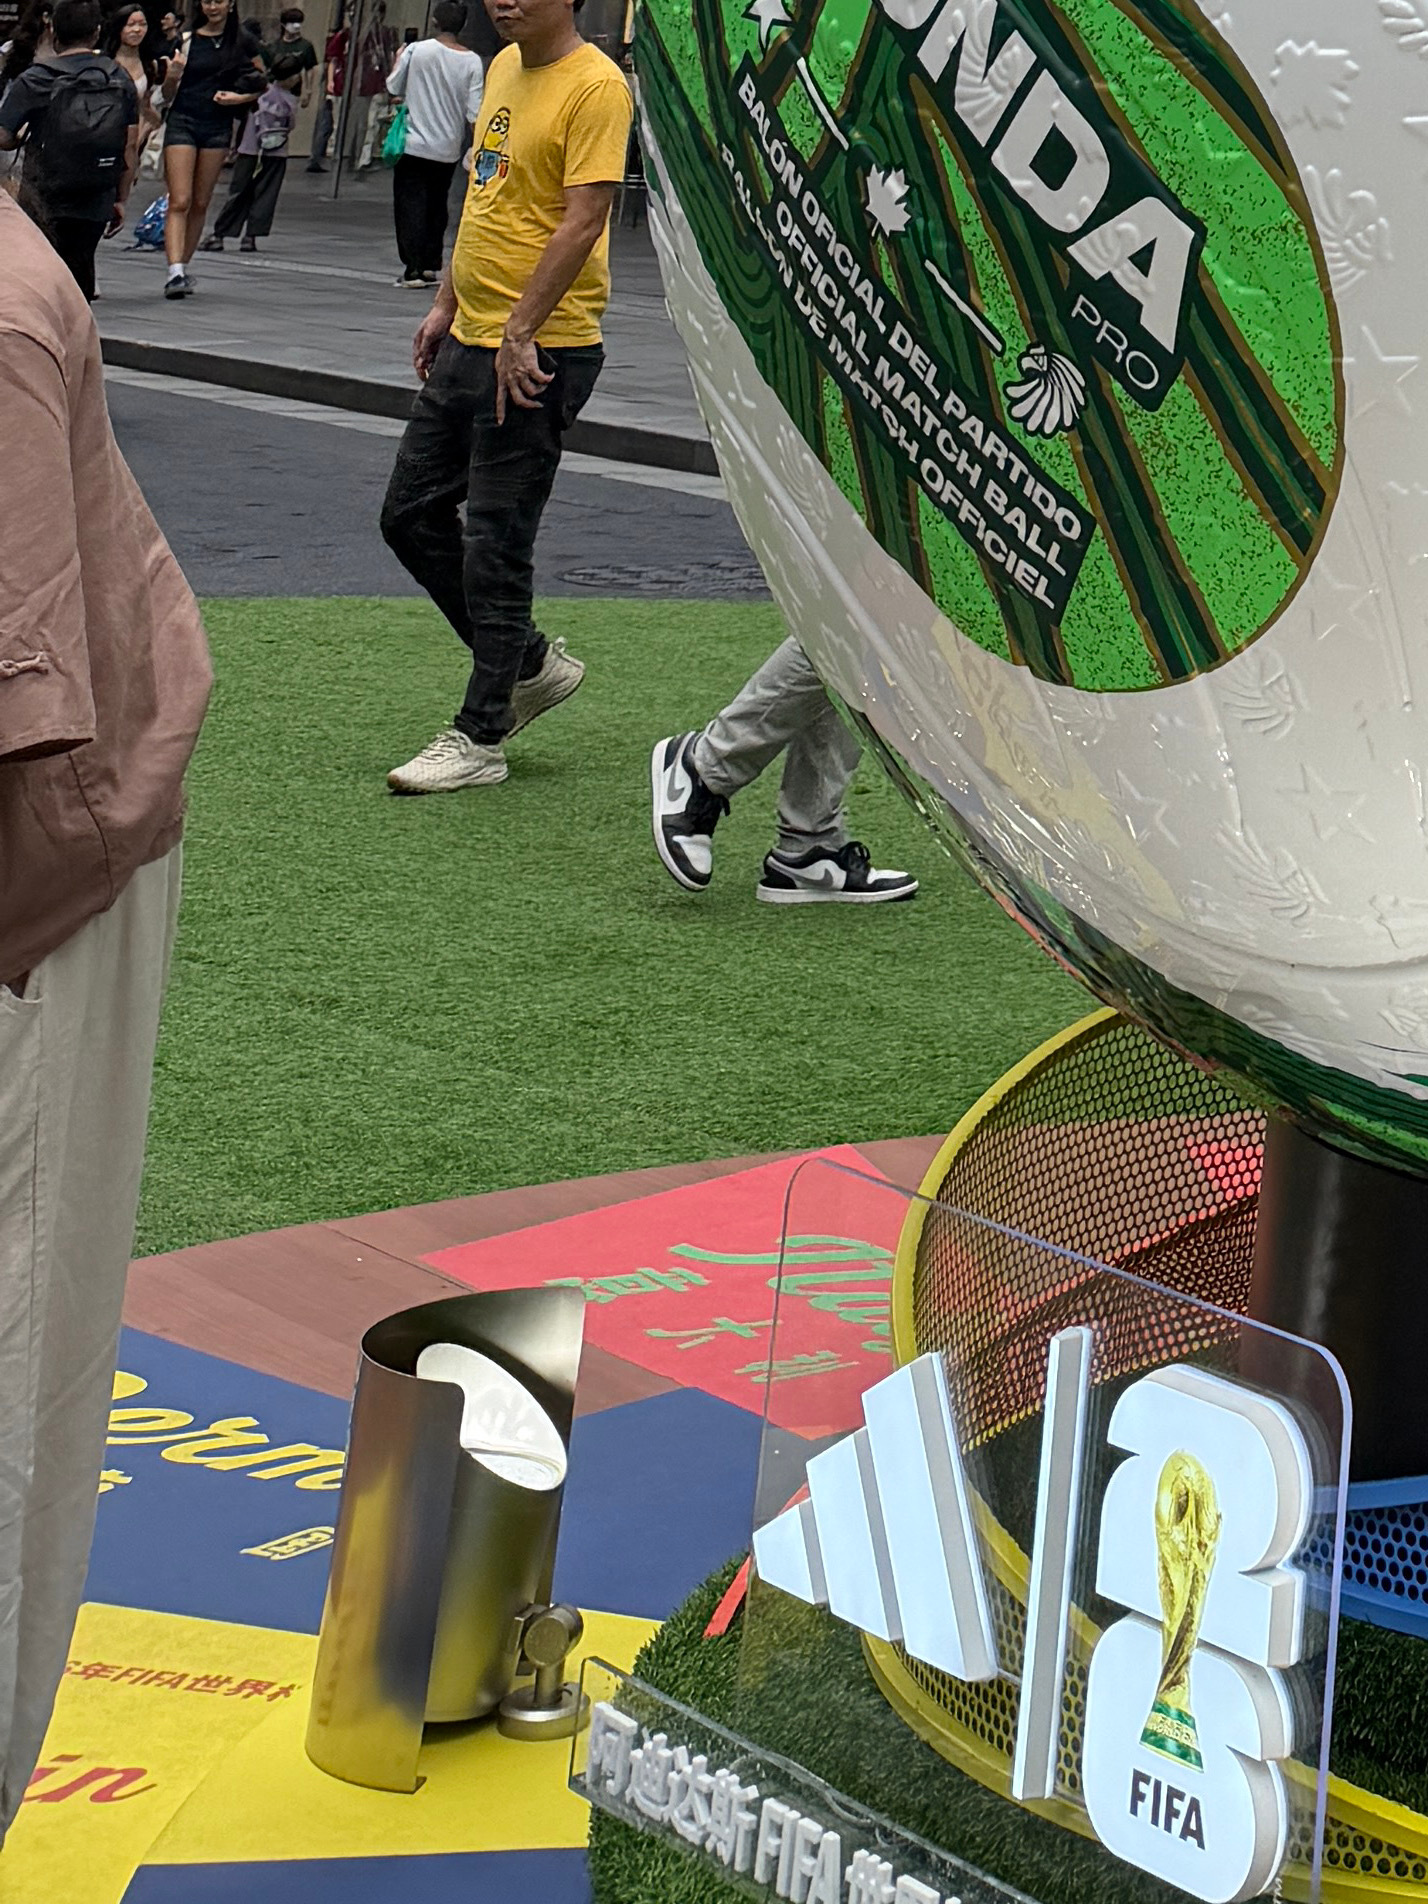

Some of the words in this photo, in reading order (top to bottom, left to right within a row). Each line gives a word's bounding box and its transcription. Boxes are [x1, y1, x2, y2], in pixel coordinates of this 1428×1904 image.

[739, 72, 804, 199] BALÓN
[801, 196, 889, 335] OFICIAL
[887, 324, 942, 402] DEL
[944, 396, 1082, 541] PARTIDO
[1071, 292, 1162, 394] PRO
[775, 200, 872, 366] OFFICIAL
[872, 360, 984, 489] MATCH
[983, 482, 1066, 577] BALL
[918, 458, 1055, 610] OFFICIEL
[1129, 1767, 1206, 1851] FIFA
